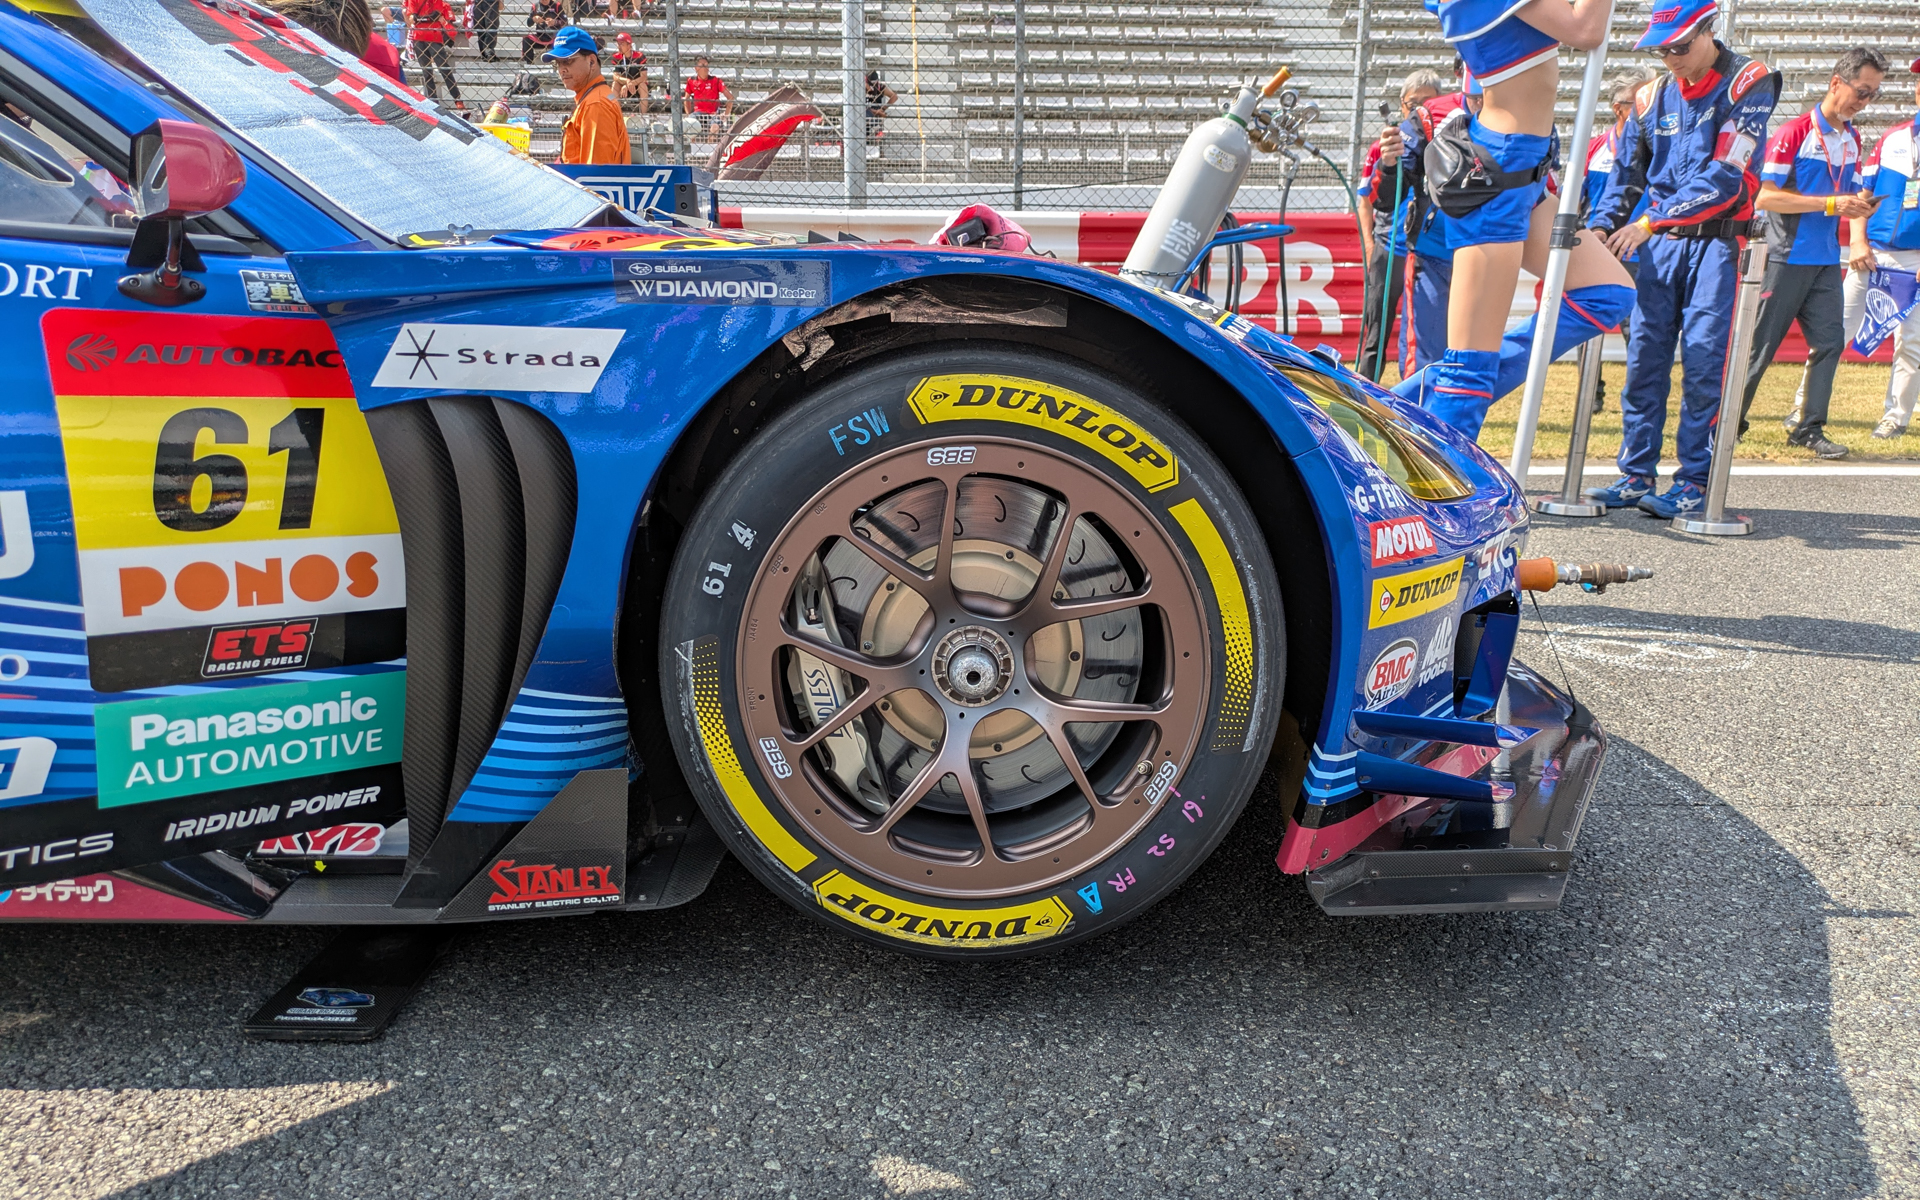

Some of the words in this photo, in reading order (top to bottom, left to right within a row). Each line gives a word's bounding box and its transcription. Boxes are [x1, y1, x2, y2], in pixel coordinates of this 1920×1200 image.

[654, 265, 701, 274] SUBARU
[779, 287, 816, 299] KeePer
[457, 347, 601, 368] Strada
[828, 405, 890, 456] FSW
[952, 384, 1169, 469] DUNLOP
[152, 407, 326, 532] 61
[926, 446, 977, 466] BBS
[1375, 521, 1433, 559] MOTUL
[118, 551, 380, 618] PONOS
[1395, 570, 1459, 608] DUNLOP
[211, 623, 312, 661] ETS
[207, 660, 261, 674] RACING
[263, 655, 303, 667] FUELS
[1372, 651, 1415, 691] BMC
[1418, 657, 1448, 688] TOOLS
[749, 686, 757, 712] FRONT
[131, 691, 378, 752] Panasonic
[125, 727, 384, 789] AUTOMOTIVE
[759, 736, 793, 779] BBS
[1143, 761, 1178, 804] BBS
[164, 804, 281, 843] IRIDIUM
[285, 785, 382, 819] POWER
[256, 823, 387, 857] KYB
[488, 860, 621, 904] STANLEY
[1107, 867, 1136, 893] FR
[488, 902, 533, 911] STANLEY
[535, 898, 581, 908] ELECTRIC
[827, 891, 1032, 940] DUNLOP
